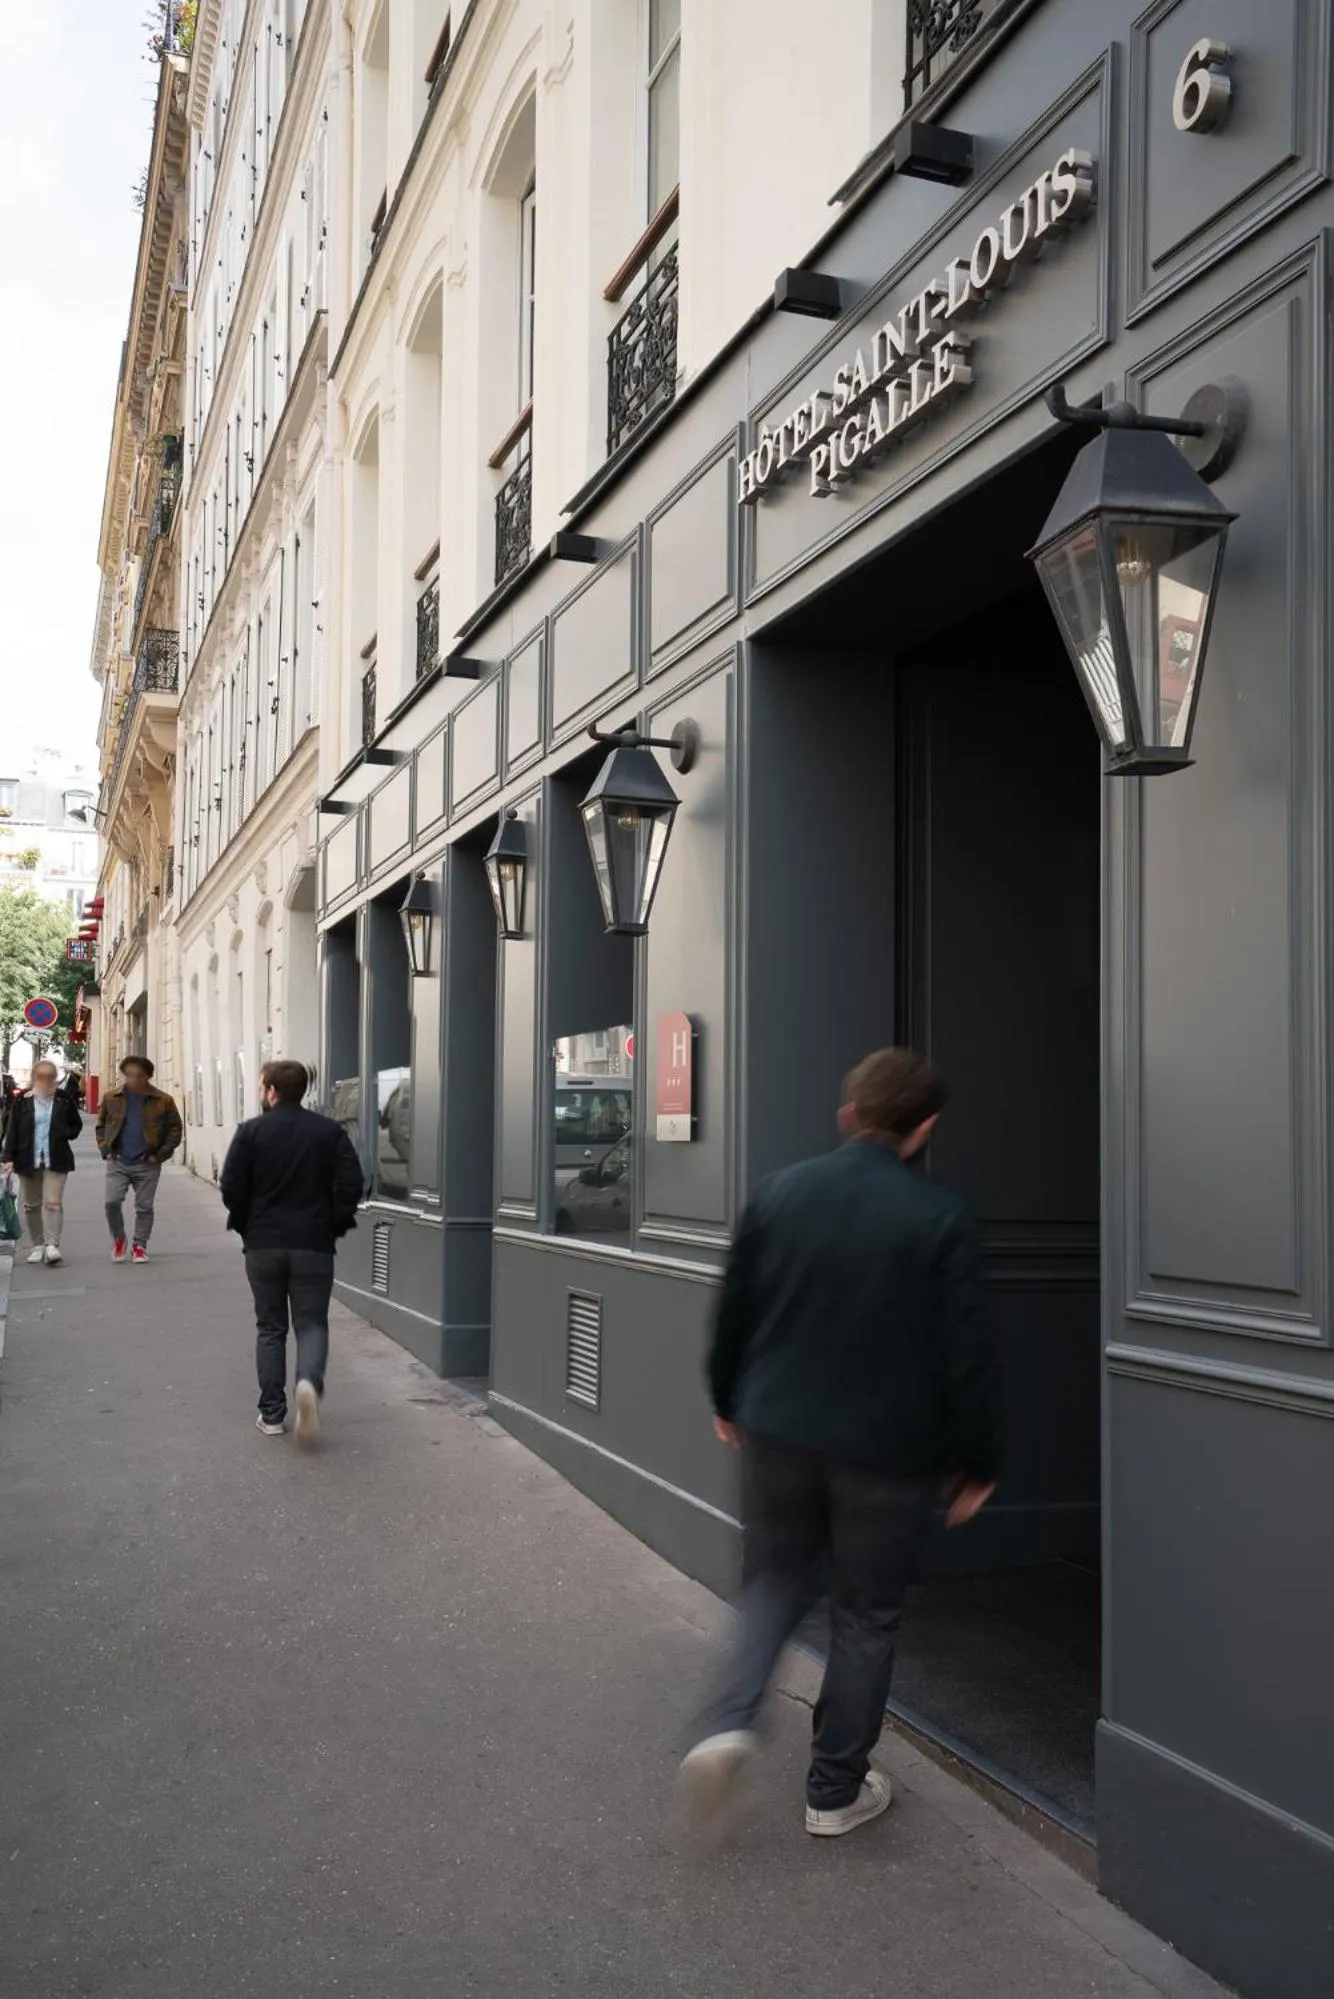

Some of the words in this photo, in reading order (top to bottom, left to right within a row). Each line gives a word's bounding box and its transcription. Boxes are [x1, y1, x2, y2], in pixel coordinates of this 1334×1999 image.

[1173, 38, 1222, 133] 6
[737, 389, 833, 504] HÔTEL
[832, 147, 1089, 418] SAINT-LOUIS
[810, 331, 969, 496] PIGALLE
[672, 1031, 687, 1068] H
